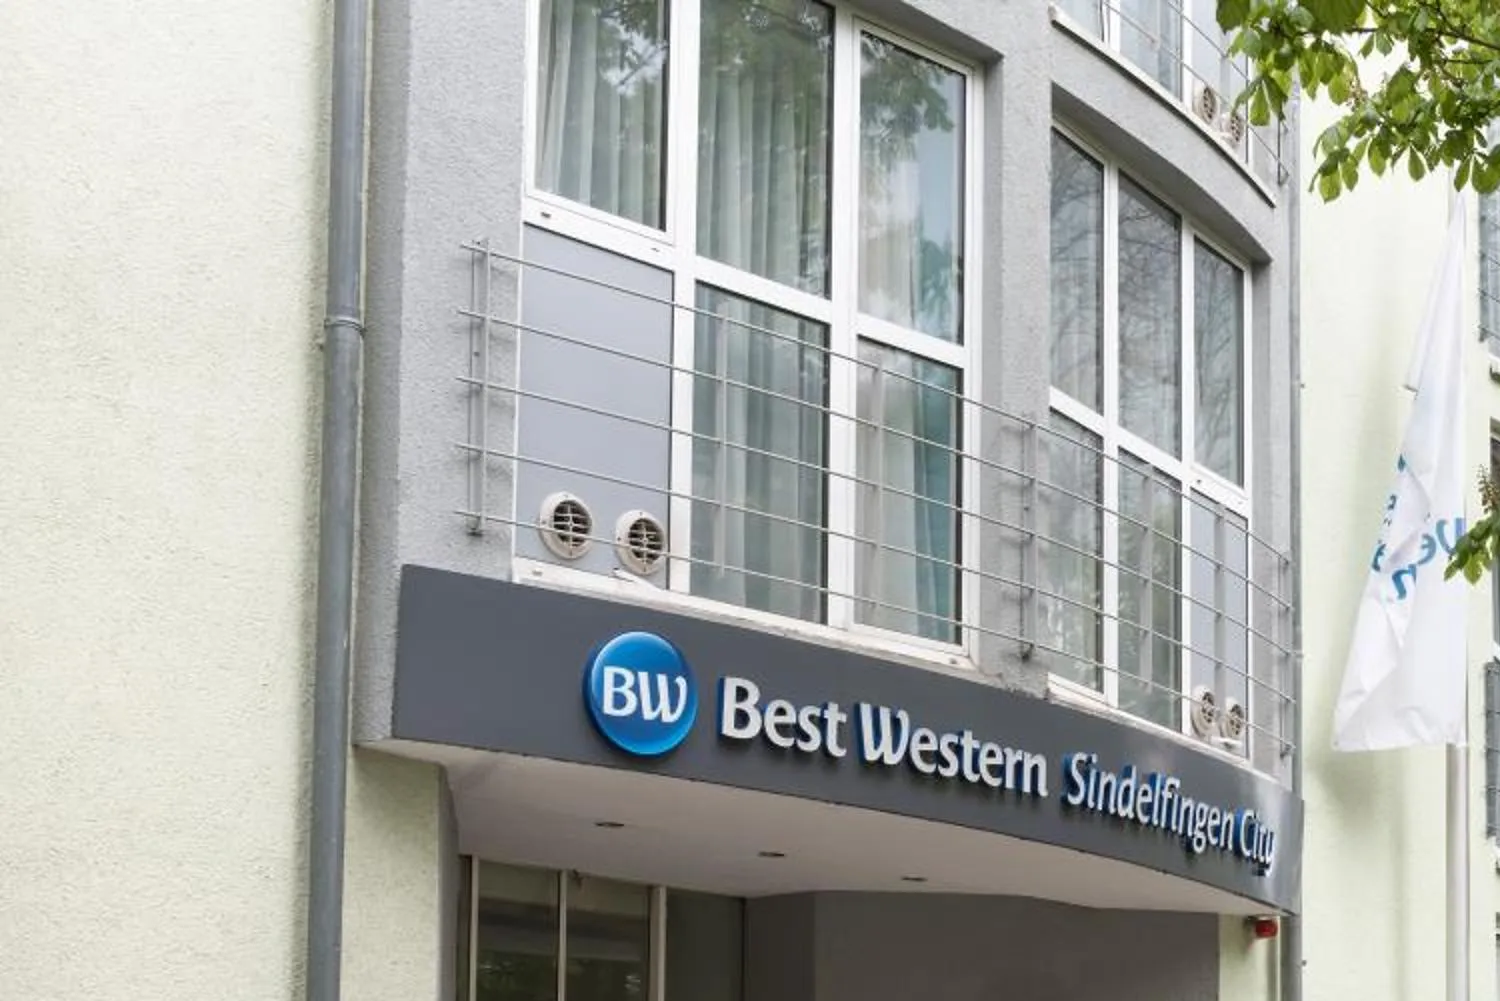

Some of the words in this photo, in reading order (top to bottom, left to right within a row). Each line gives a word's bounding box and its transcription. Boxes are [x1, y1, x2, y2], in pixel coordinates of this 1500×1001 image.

[602, 665, 688, 723] BW
[719, 676, 848, 758] Best
[857, 702, 1049, 797] Western
[1065, 751, 1234, 854] Sindelfingen
[1239, 809, 1276, 877] City
